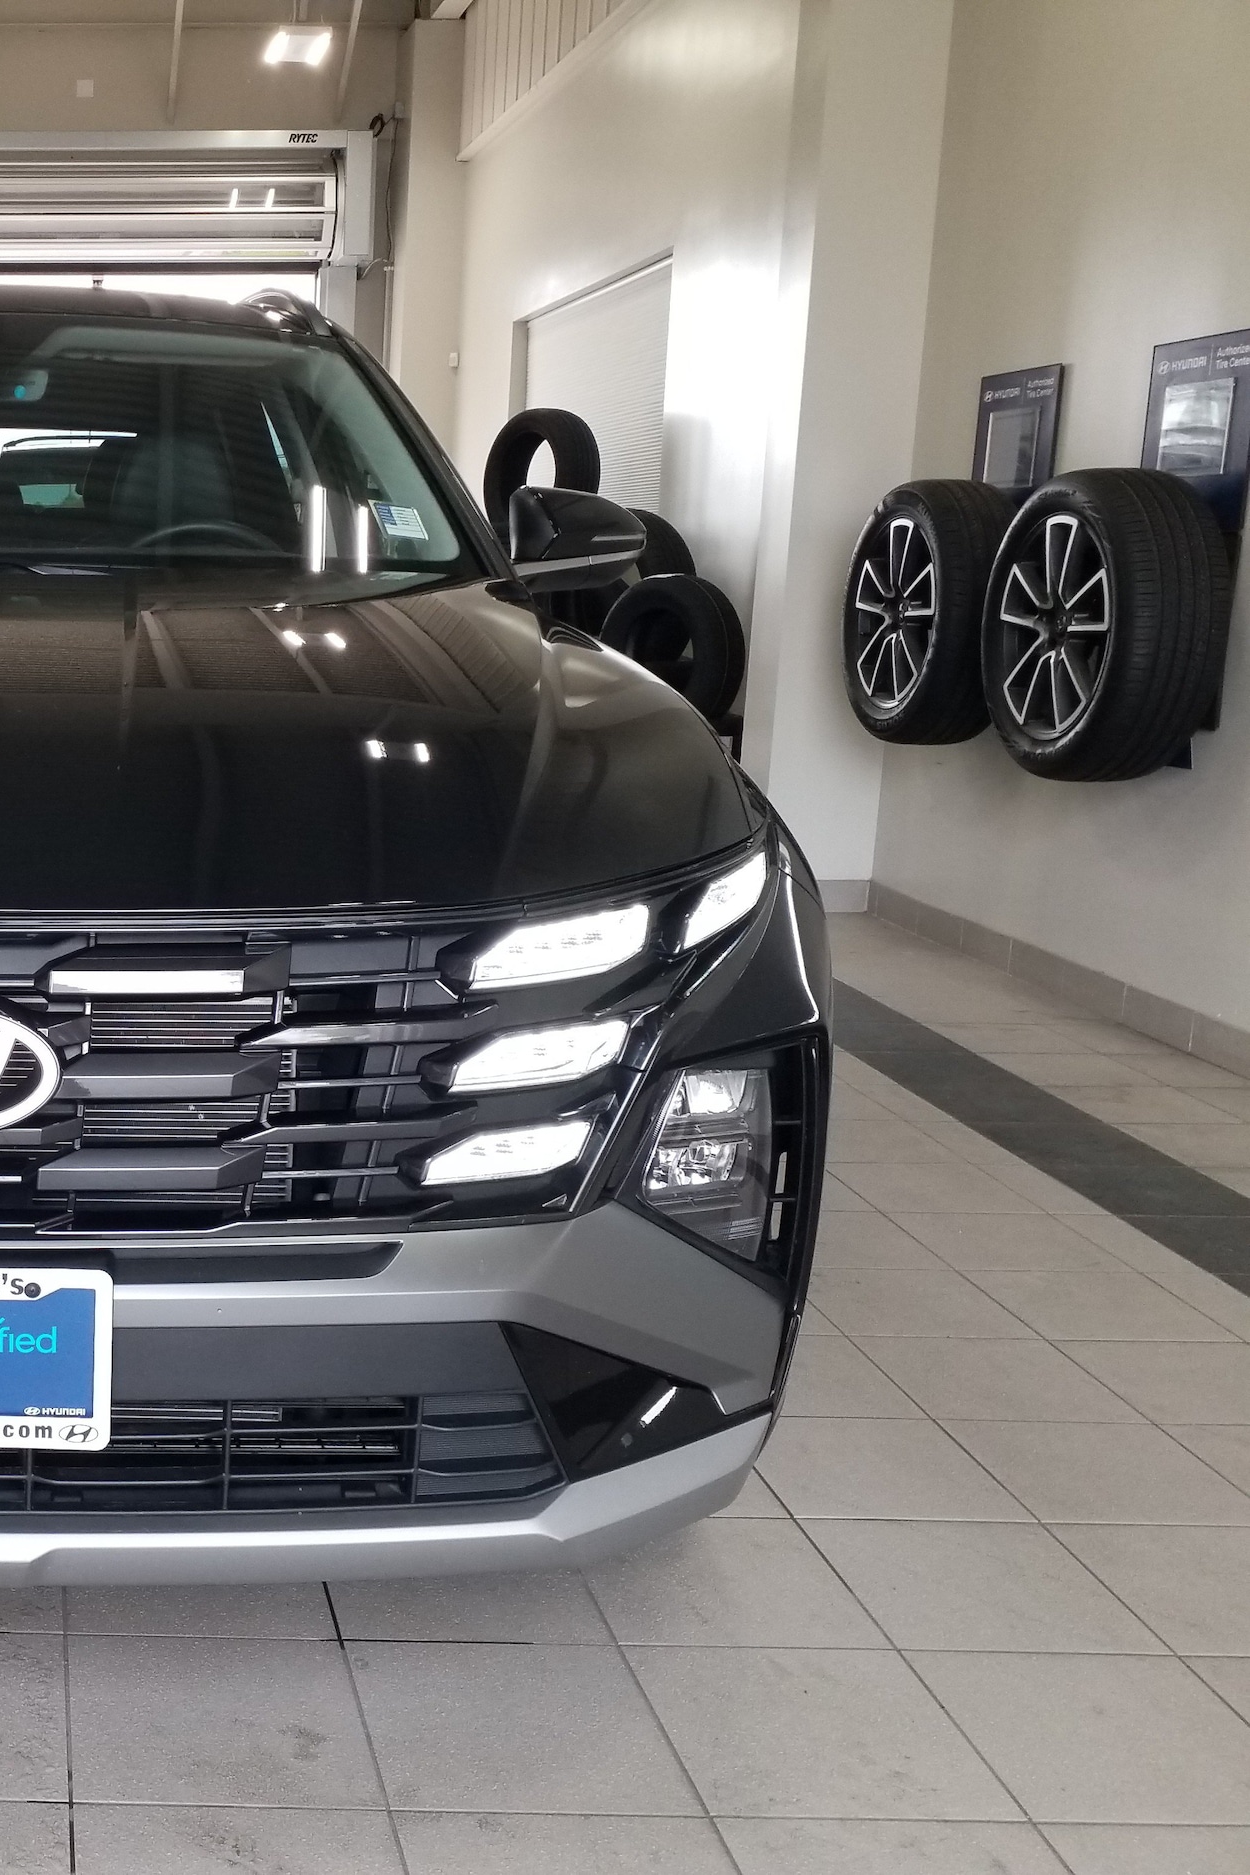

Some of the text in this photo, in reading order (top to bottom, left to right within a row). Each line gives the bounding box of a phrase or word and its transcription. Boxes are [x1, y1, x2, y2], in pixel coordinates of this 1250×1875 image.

[288, 133, 318, 143] RYTEC
[1171, 356, 1207, 371] HYUNDAI
[1229, 357, 1250, 367] Cente
[41, 1407, 86, 1416] HYUNDAI
